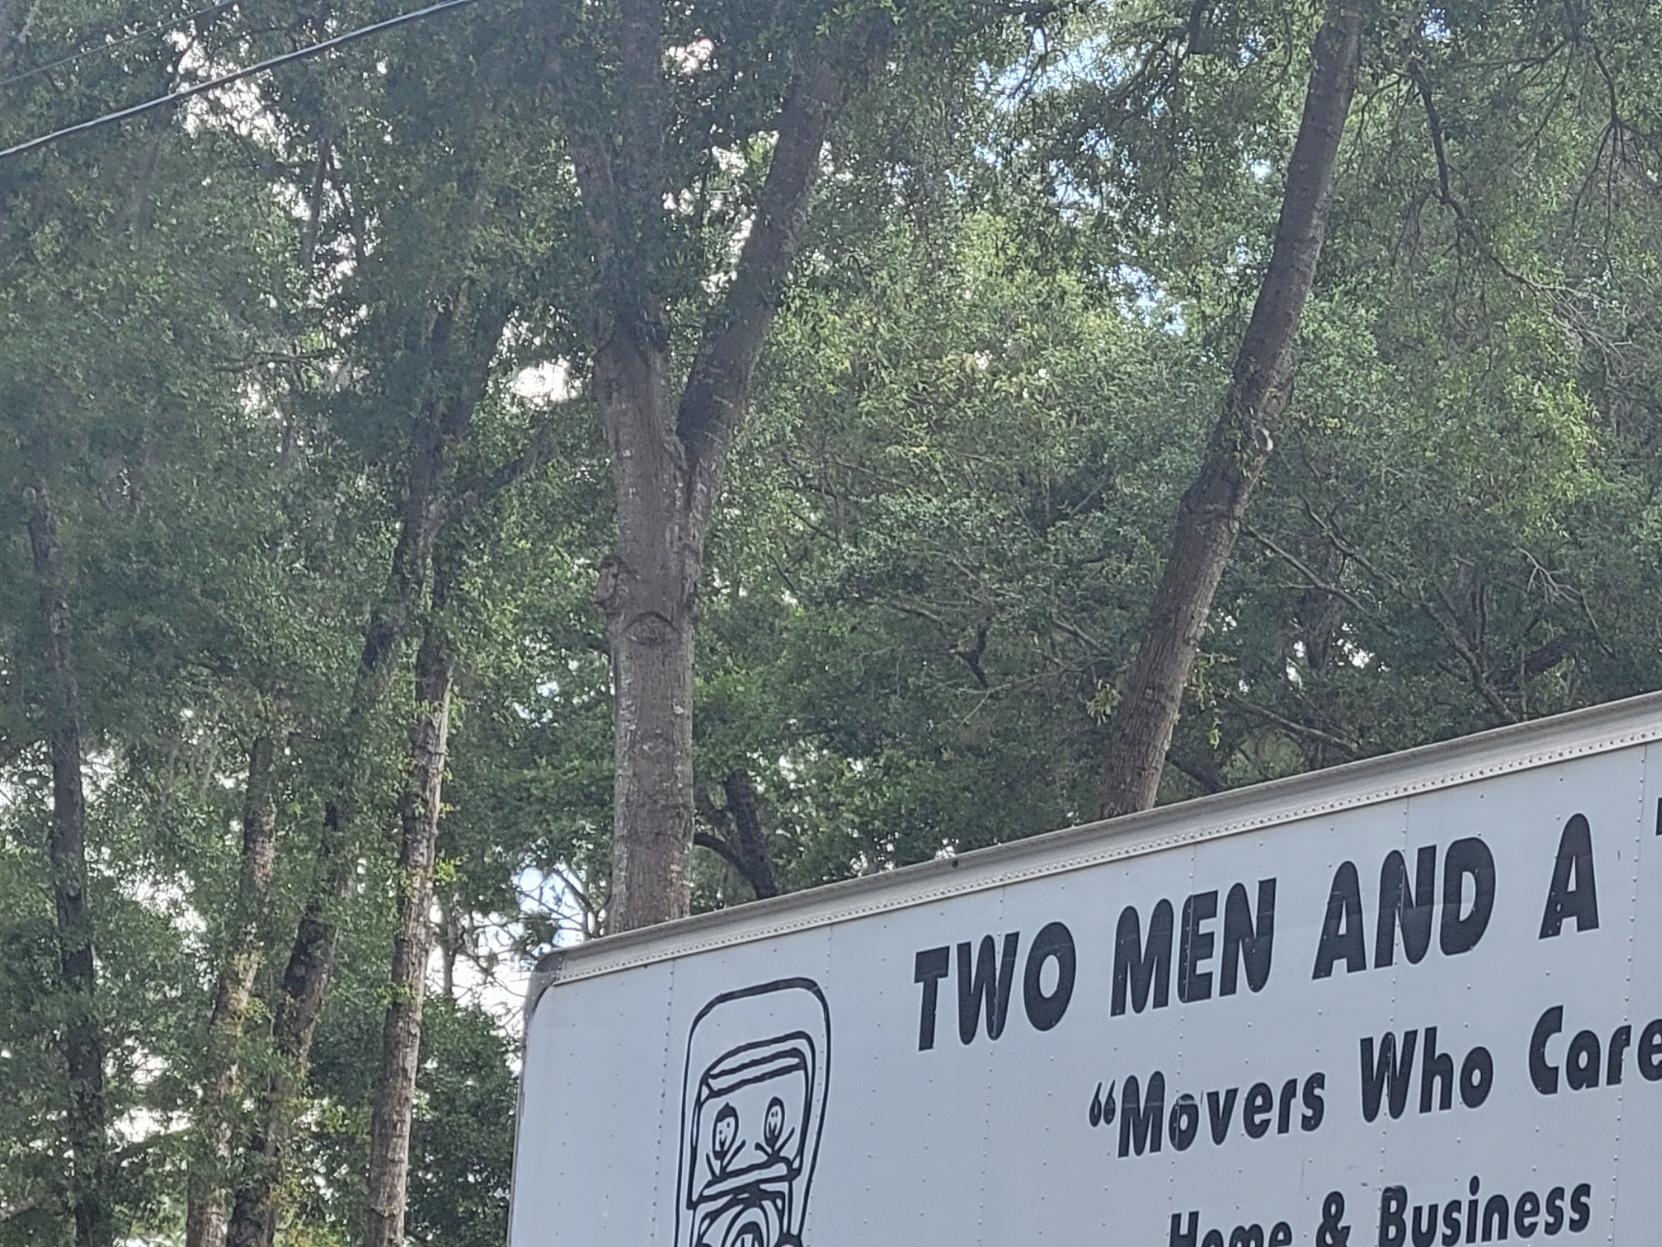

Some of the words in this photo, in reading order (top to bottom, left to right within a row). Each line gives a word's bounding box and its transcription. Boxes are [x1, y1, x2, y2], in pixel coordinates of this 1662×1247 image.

[914, 921, 1077, 1052] TWO
[1110, 877, 1277, 1016] MEN
[1311, 836, 1496, 980] AND
[1538, 813, 1599, 940] A
[1360, 1025, 1493, 1123] Who
